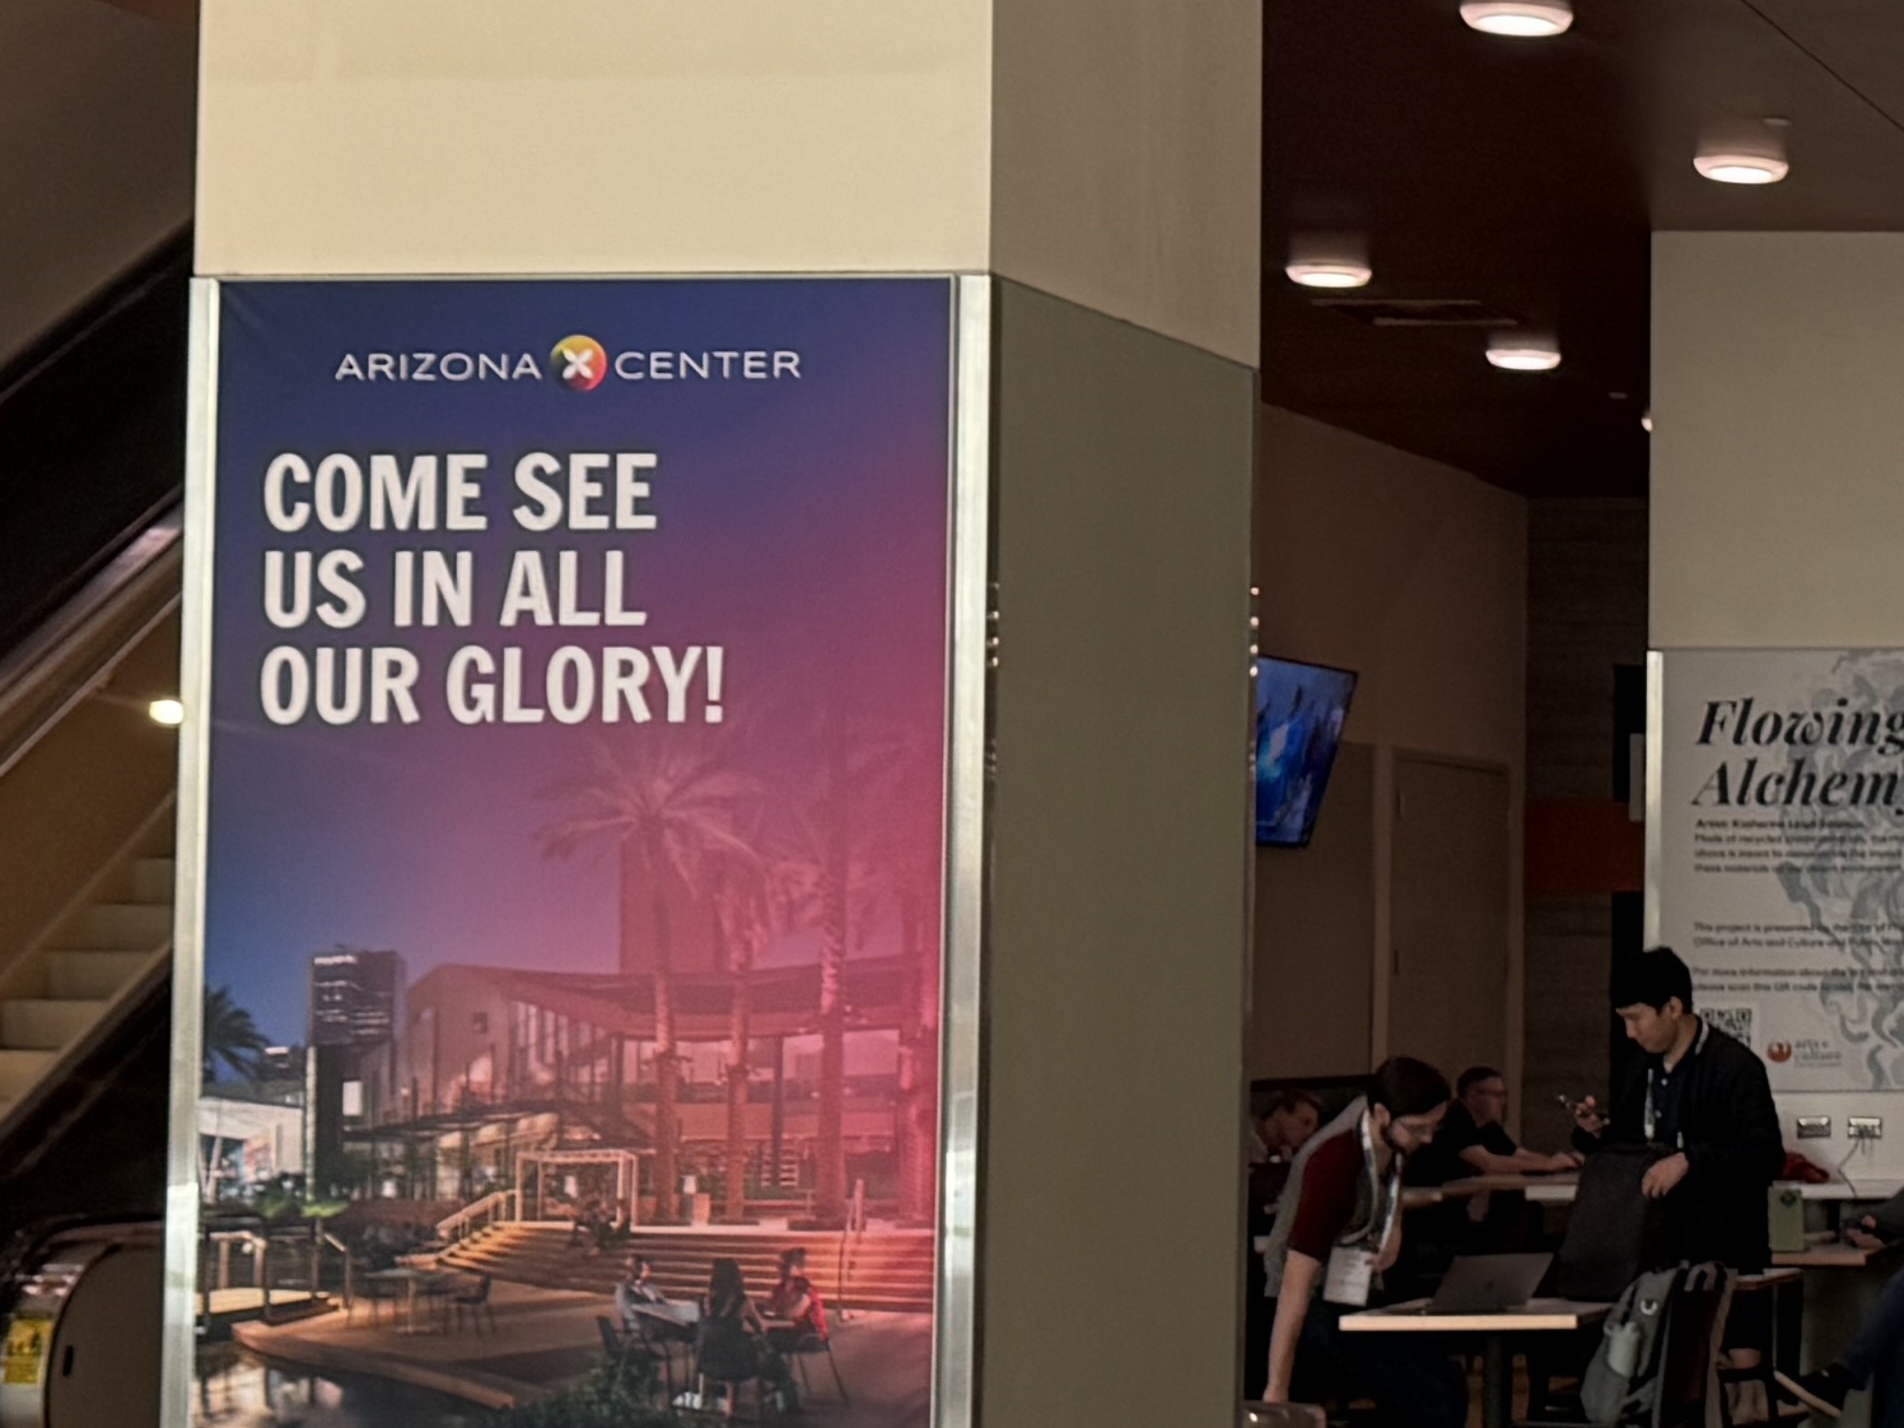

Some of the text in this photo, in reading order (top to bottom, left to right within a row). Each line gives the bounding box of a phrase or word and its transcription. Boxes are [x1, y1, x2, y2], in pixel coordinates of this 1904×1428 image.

[336, 351, 800, 380] ARIZONA CENTER
[265, 453, 656, 531] COME SEE
[265, 550, 646, 628] US IN ALL
[262, 646, 722, 724] OUR GLORY!
